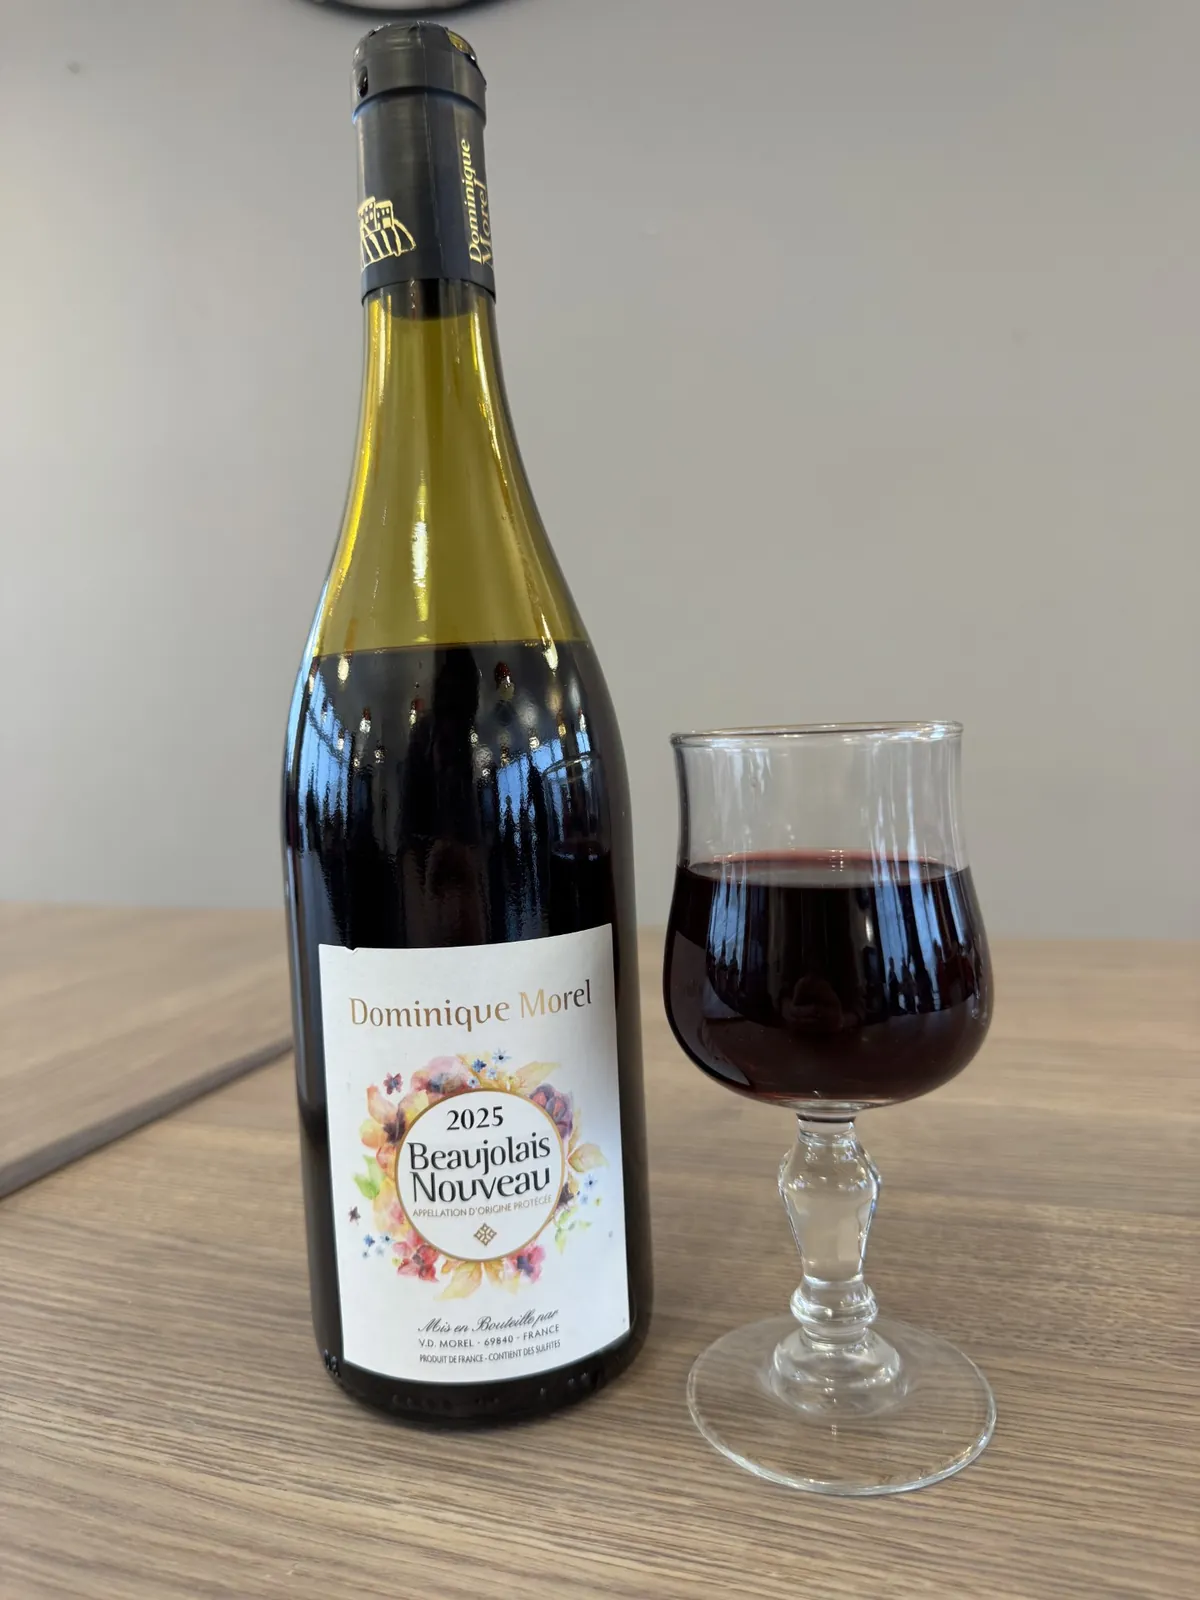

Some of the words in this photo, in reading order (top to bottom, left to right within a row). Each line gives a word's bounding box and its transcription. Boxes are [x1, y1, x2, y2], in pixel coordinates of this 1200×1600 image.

[460, 138, 482, 264] Dominique
[349, 997, 510, 1033] Dominique
[518, 979, 592, 1018] Morel
[446, 1105, 504, 1131] 2025
[407, 1132, 551, 1176] Beaujolais
[410, 1167, 551, 1203] Nouveau
[412, 1207, 467, 1218] APPELLATION
[468, 1201, 512, 1216] D'ORIGINE
[513, 1194, 552, 1211] PROTÉGÉE
[417, 1317, 452, 1333] Mis
[453, 1324, 470, 1333] en
[472, 1308, 535, 1333] Bouteille
[532, 1309, 560, 1329] par
[418, 1338, 437, 1348] V.D.
[439, 1338, 474, 1348] MOREL
[483, 1335, 514, 1346] 69840
[523, 1323, 560, 1341] FRANCE
[419, 1353, 447, 1364] PRODUIT
[448, 1353, 457, 1364] DE
[458, 1353, 484, 1364] FRANCE
[488, 1349, 522, 1362] CONTIENT
[523, 1346, 535, 1357] DES
[535, 1339, 561, 1354] SULFITES
